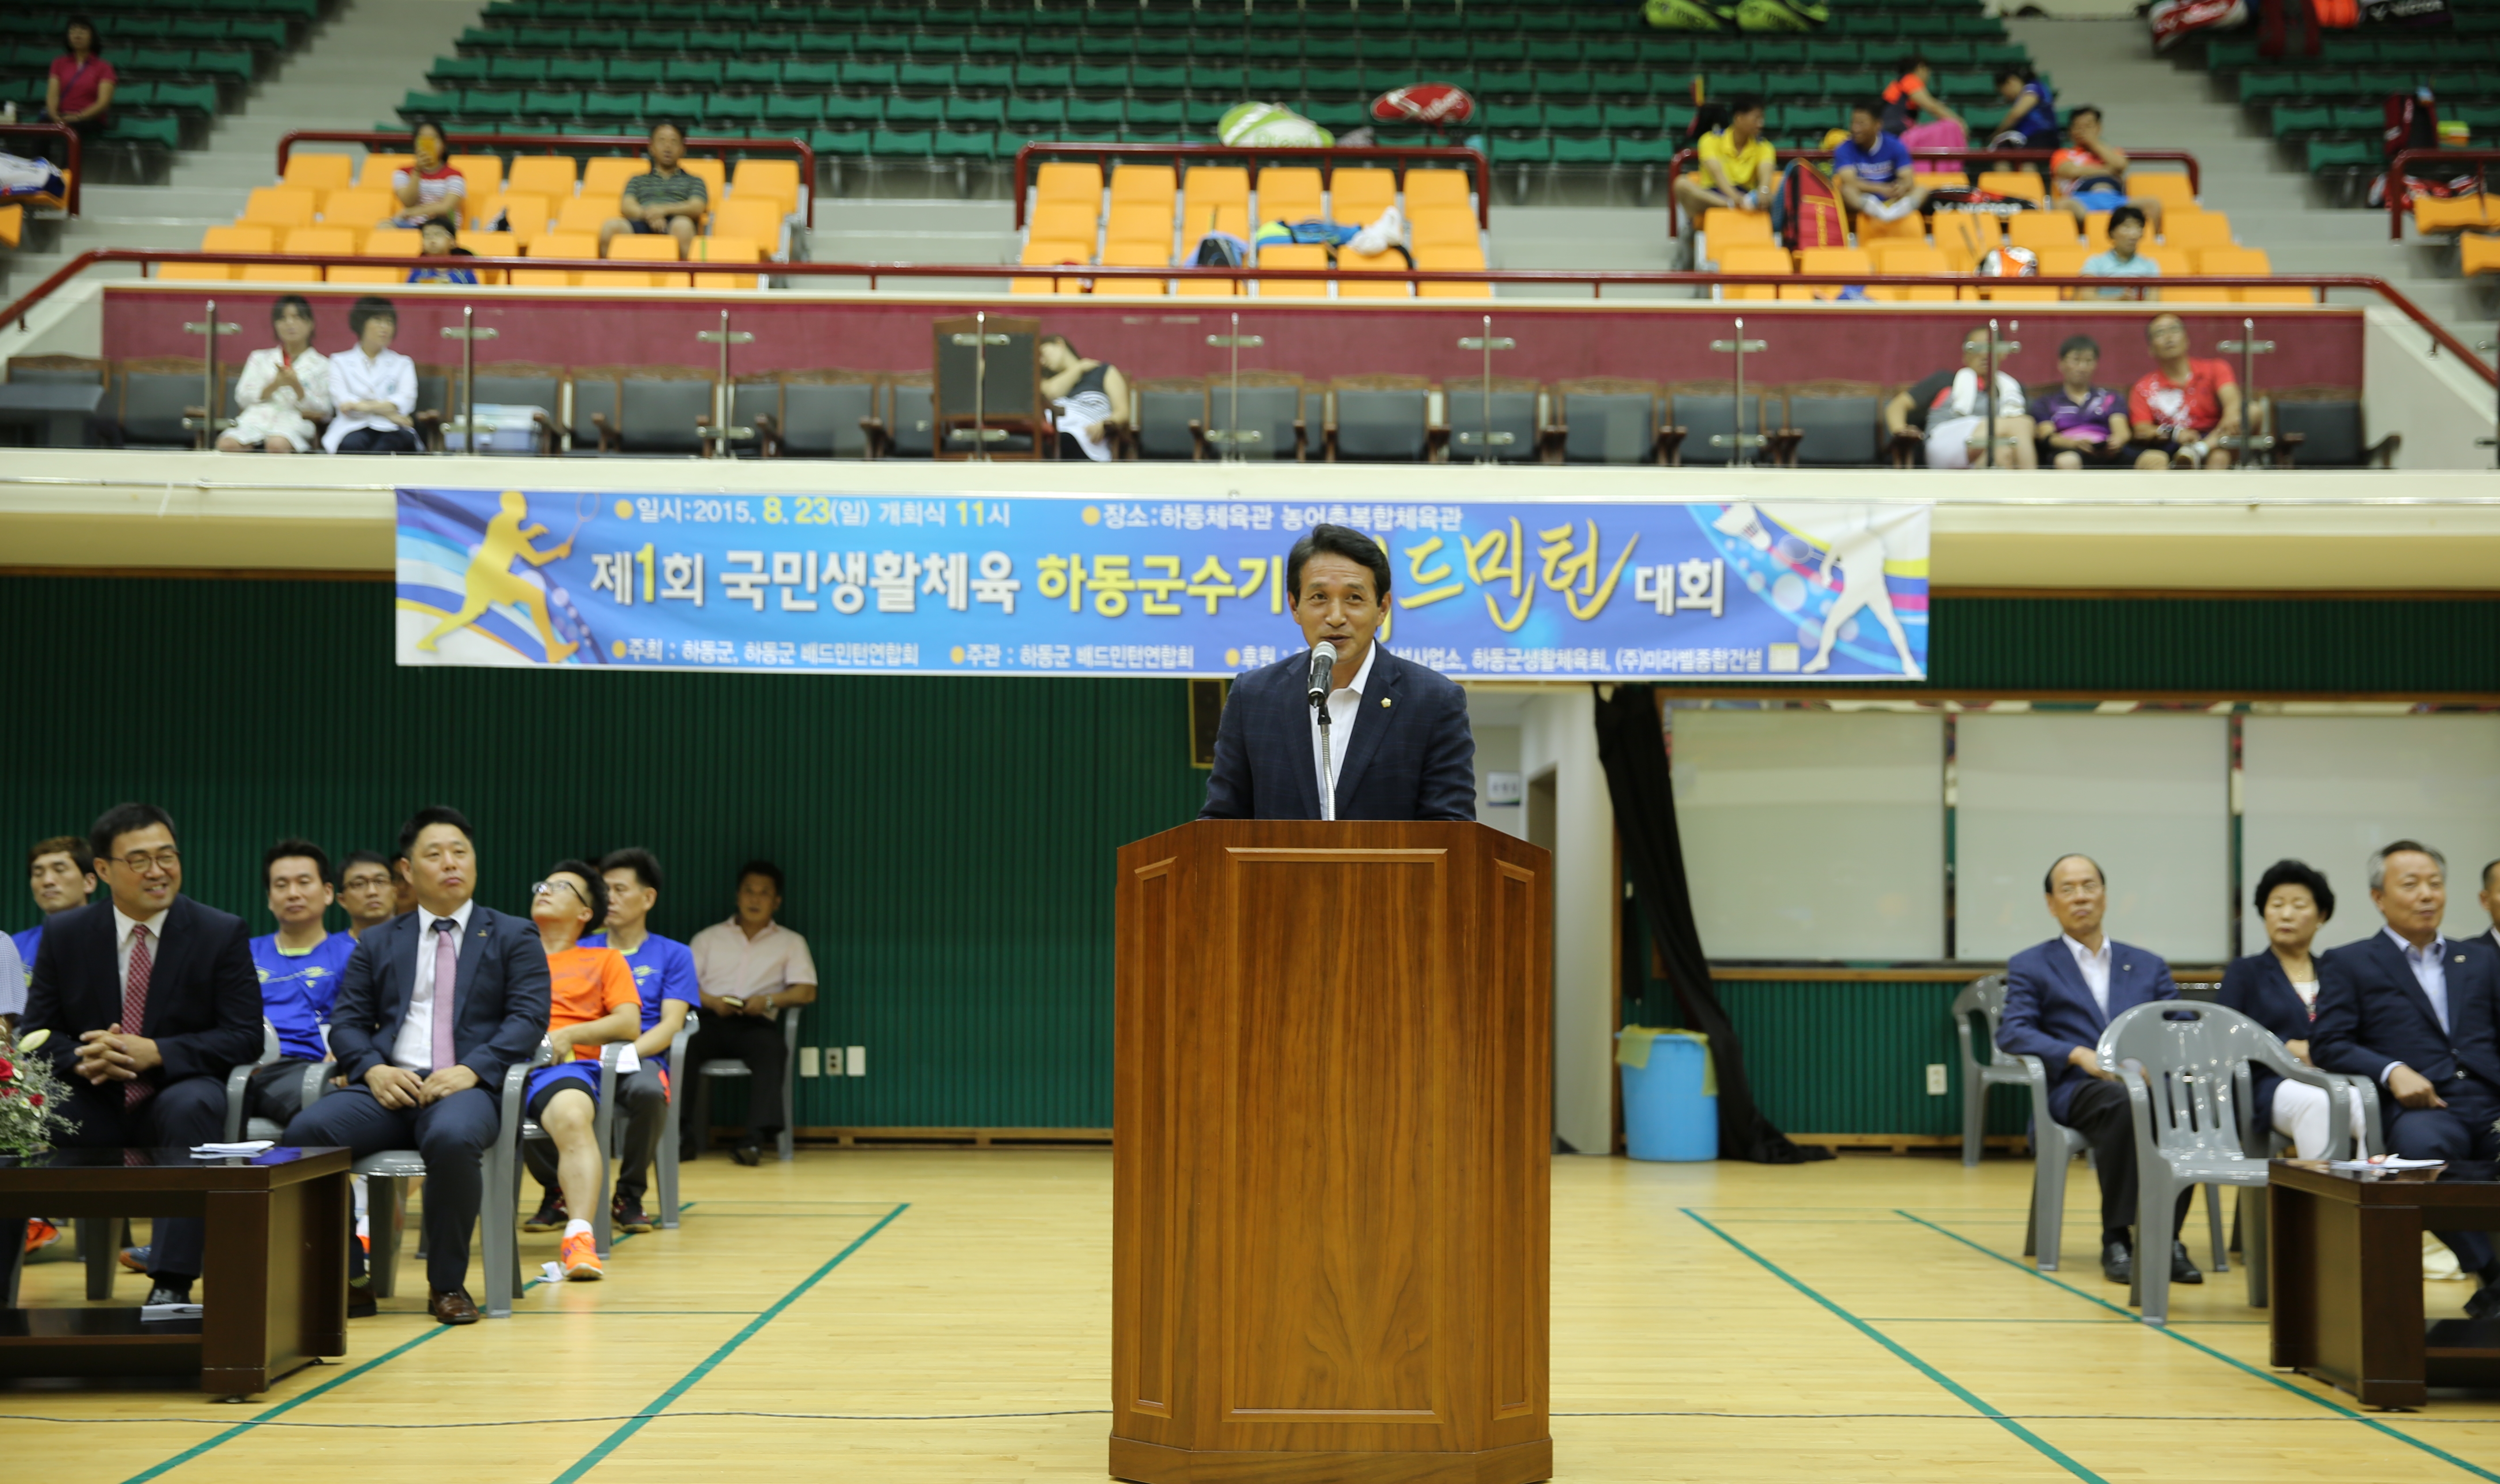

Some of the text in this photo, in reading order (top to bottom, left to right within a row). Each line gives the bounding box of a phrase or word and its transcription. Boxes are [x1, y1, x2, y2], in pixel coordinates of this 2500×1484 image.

[636, 497, 1010, 527] 일시:2015. 8. 23(일) 개회식 11시
[1104, 504, 1463, 532] 장소:하동체육관 농어촌복합체육관
[590, 516, 1724, 643] 제1회 국민생활체육 하동군수기 드민턴 대회
[628, 638, 663, 662] 주최
[681, 640, 739, 664] 하동군,
[744, 641, 795, 665] 하동군
[801, 642, 919, 667] 배드민턴연합회
[966, 643, 1002, 667] 주관
[1020, 644, 1071, 668] 하동군
[1076, 644, 1194, 669] 배드민턴연합회
[1472, 647, 1611, 673] 하동군생활체육회,
